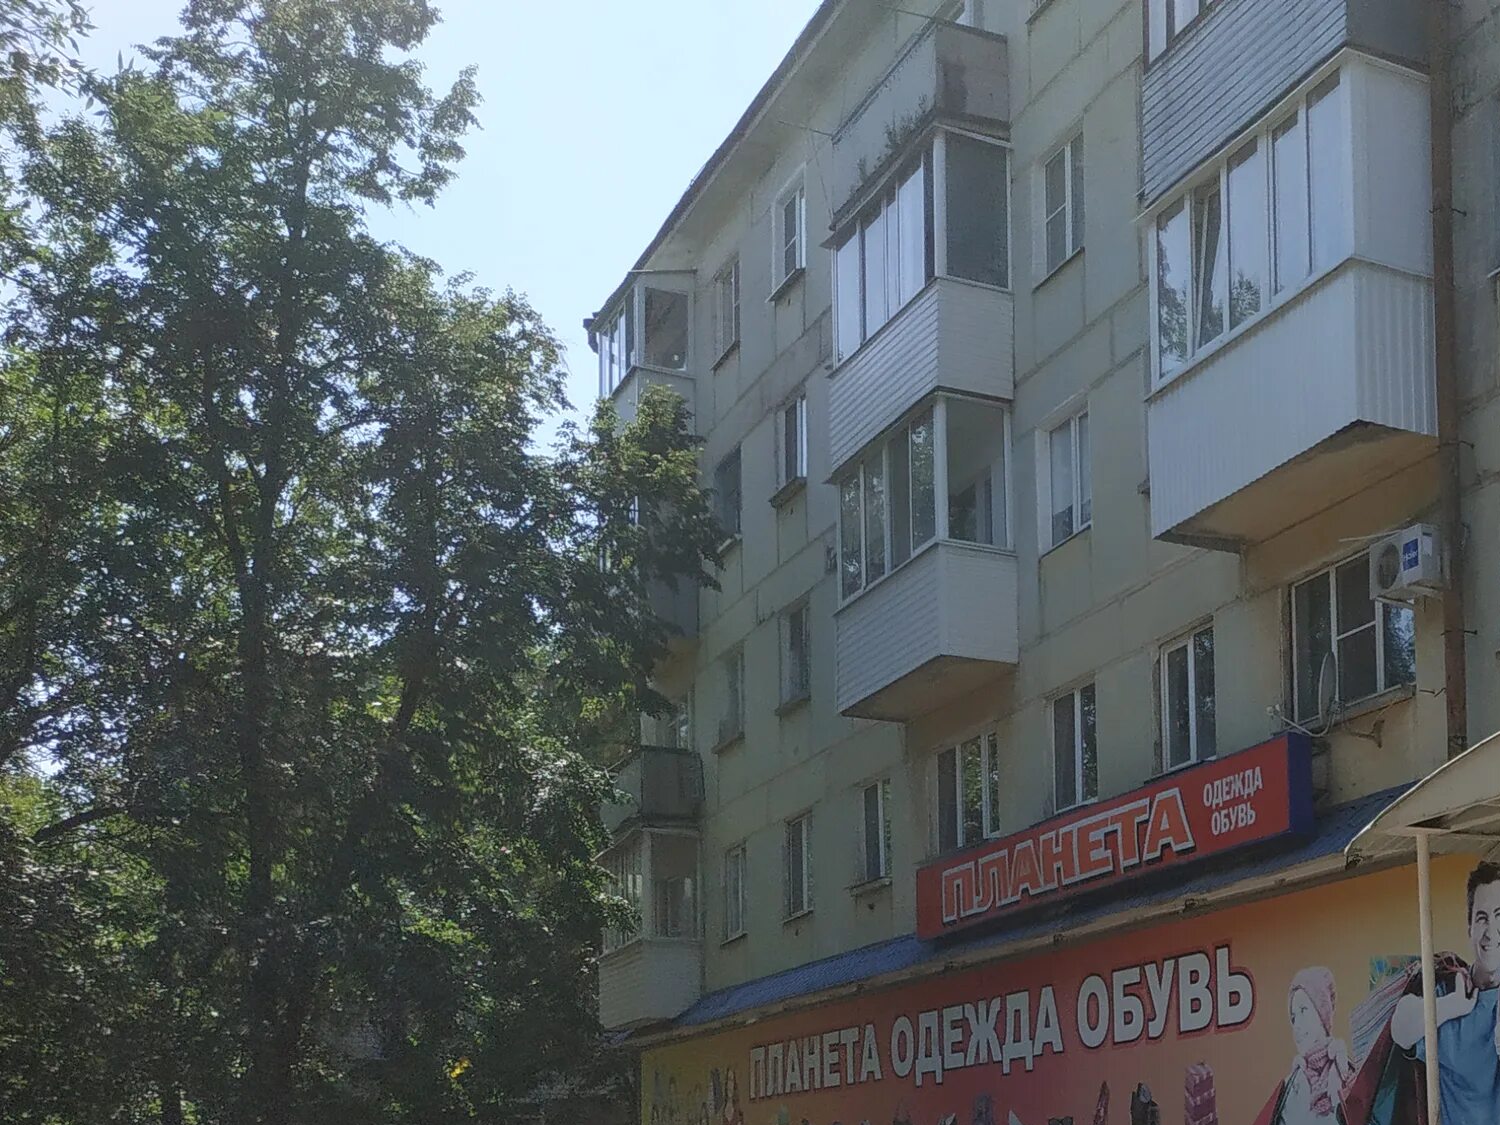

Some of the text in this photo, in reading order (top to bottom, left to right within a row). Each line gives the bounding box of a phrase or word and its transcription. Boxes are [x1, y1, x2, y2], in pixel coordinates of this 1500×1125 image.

[1203, 766, 1263, 808] ОДЕЖДА
[1211, 801, 1256, 836] ОБУВЬ
[941, 787, 1195, 925] ПЛАНЕТА
[749, 947, 1255, 1099] ПЛАНЕТА ОДЕЖДА ОБУВЬ
